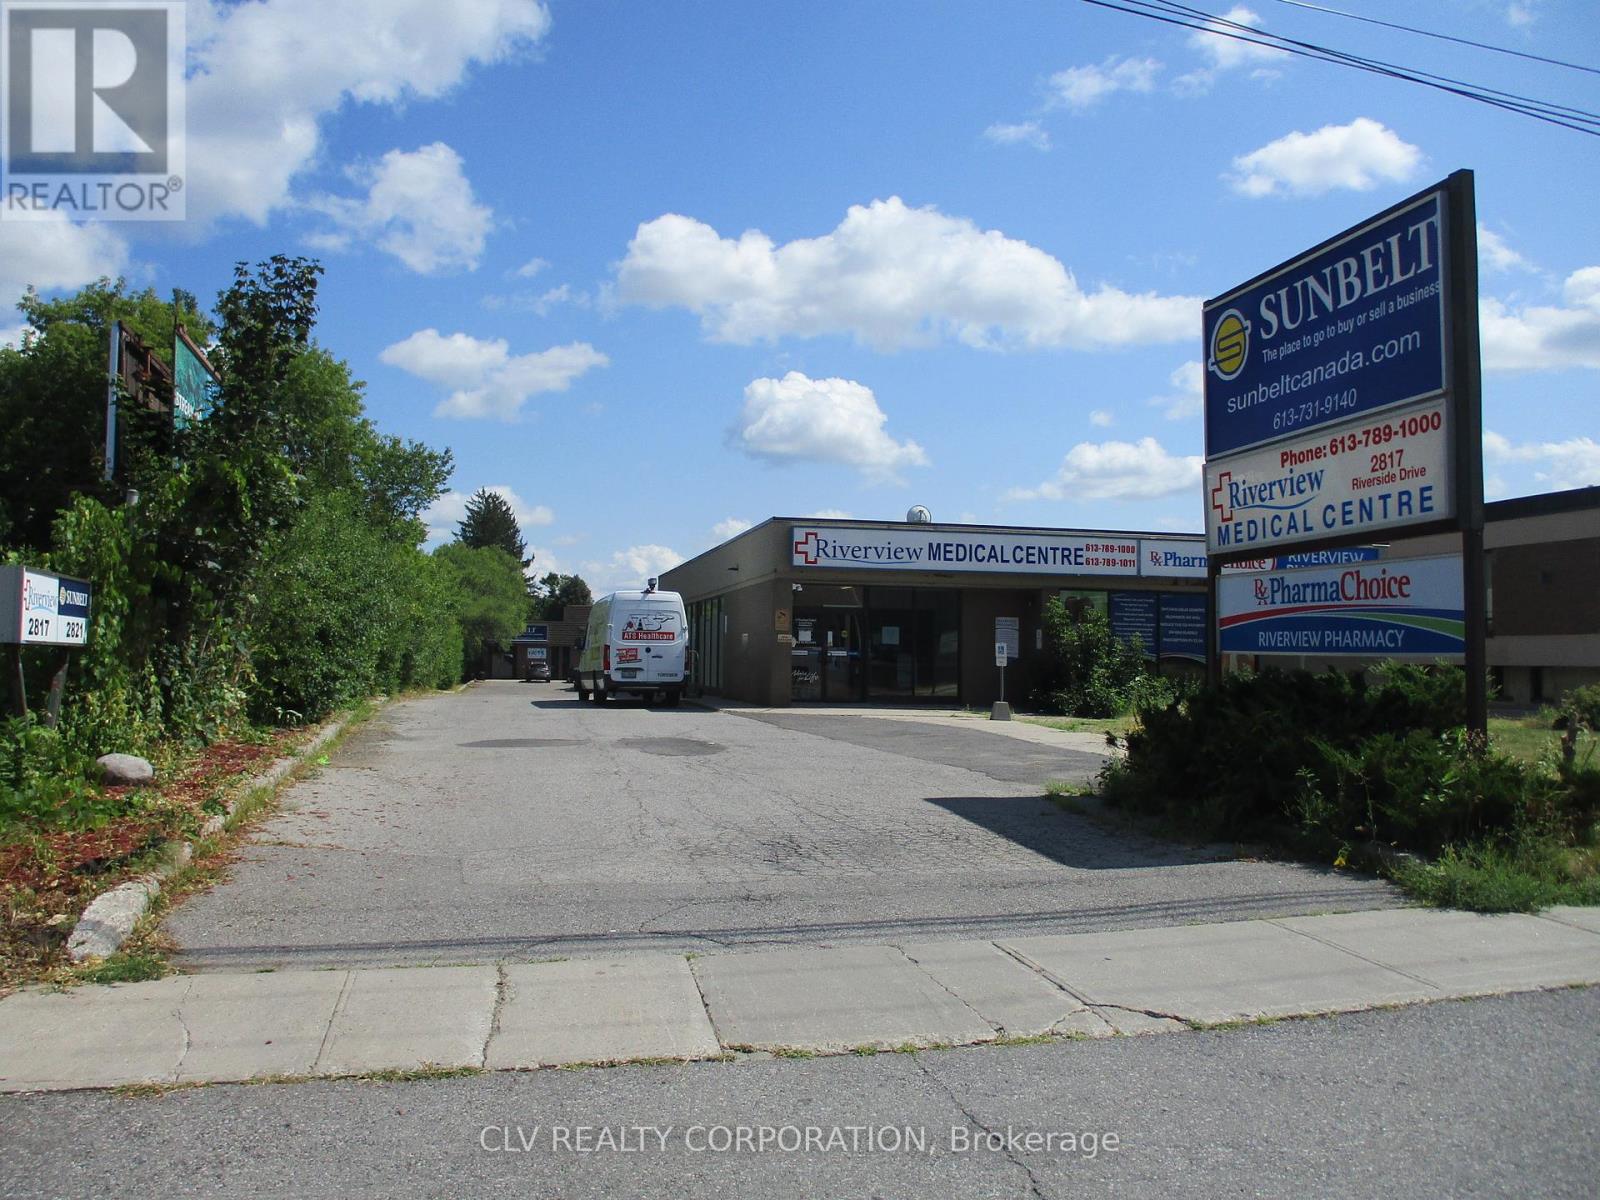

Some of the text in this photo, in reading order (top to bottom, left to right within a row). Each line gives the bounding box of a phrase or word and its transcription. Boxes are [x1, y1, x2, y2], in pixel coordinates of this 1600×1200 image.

[1259, 215, 1438, 340] SUNBELT
[1262, 280, 1440, 363] The place to go to buy or sell a business
[1227, 330, 1420, 413] sunbeltcanada.com
[1273, 388, 1357, 430] 613-731-9140
[1280, 411, 1441, 469] Phone: 613-789-1000
[1351, 466, 1427, 490] Riverside Drive
[1370, 449, 1404, 473] 2817
[1229, 467, 1325, 509] Riverview
[1217, 485, 1434, 546] MEDICAL CENTRE
[814, 538, 1084, 567] Riverview MEDICAL CENTRE
[1269, 568, 1411, 605] PharmaChoice
[28, 617, 50, 636] 2817
[66, 621, 83, 638] 2821
[638, 632, 674, 640] Healthcare
[1258, 630, 1405, 648] RIVERVIEW PHARMACY
